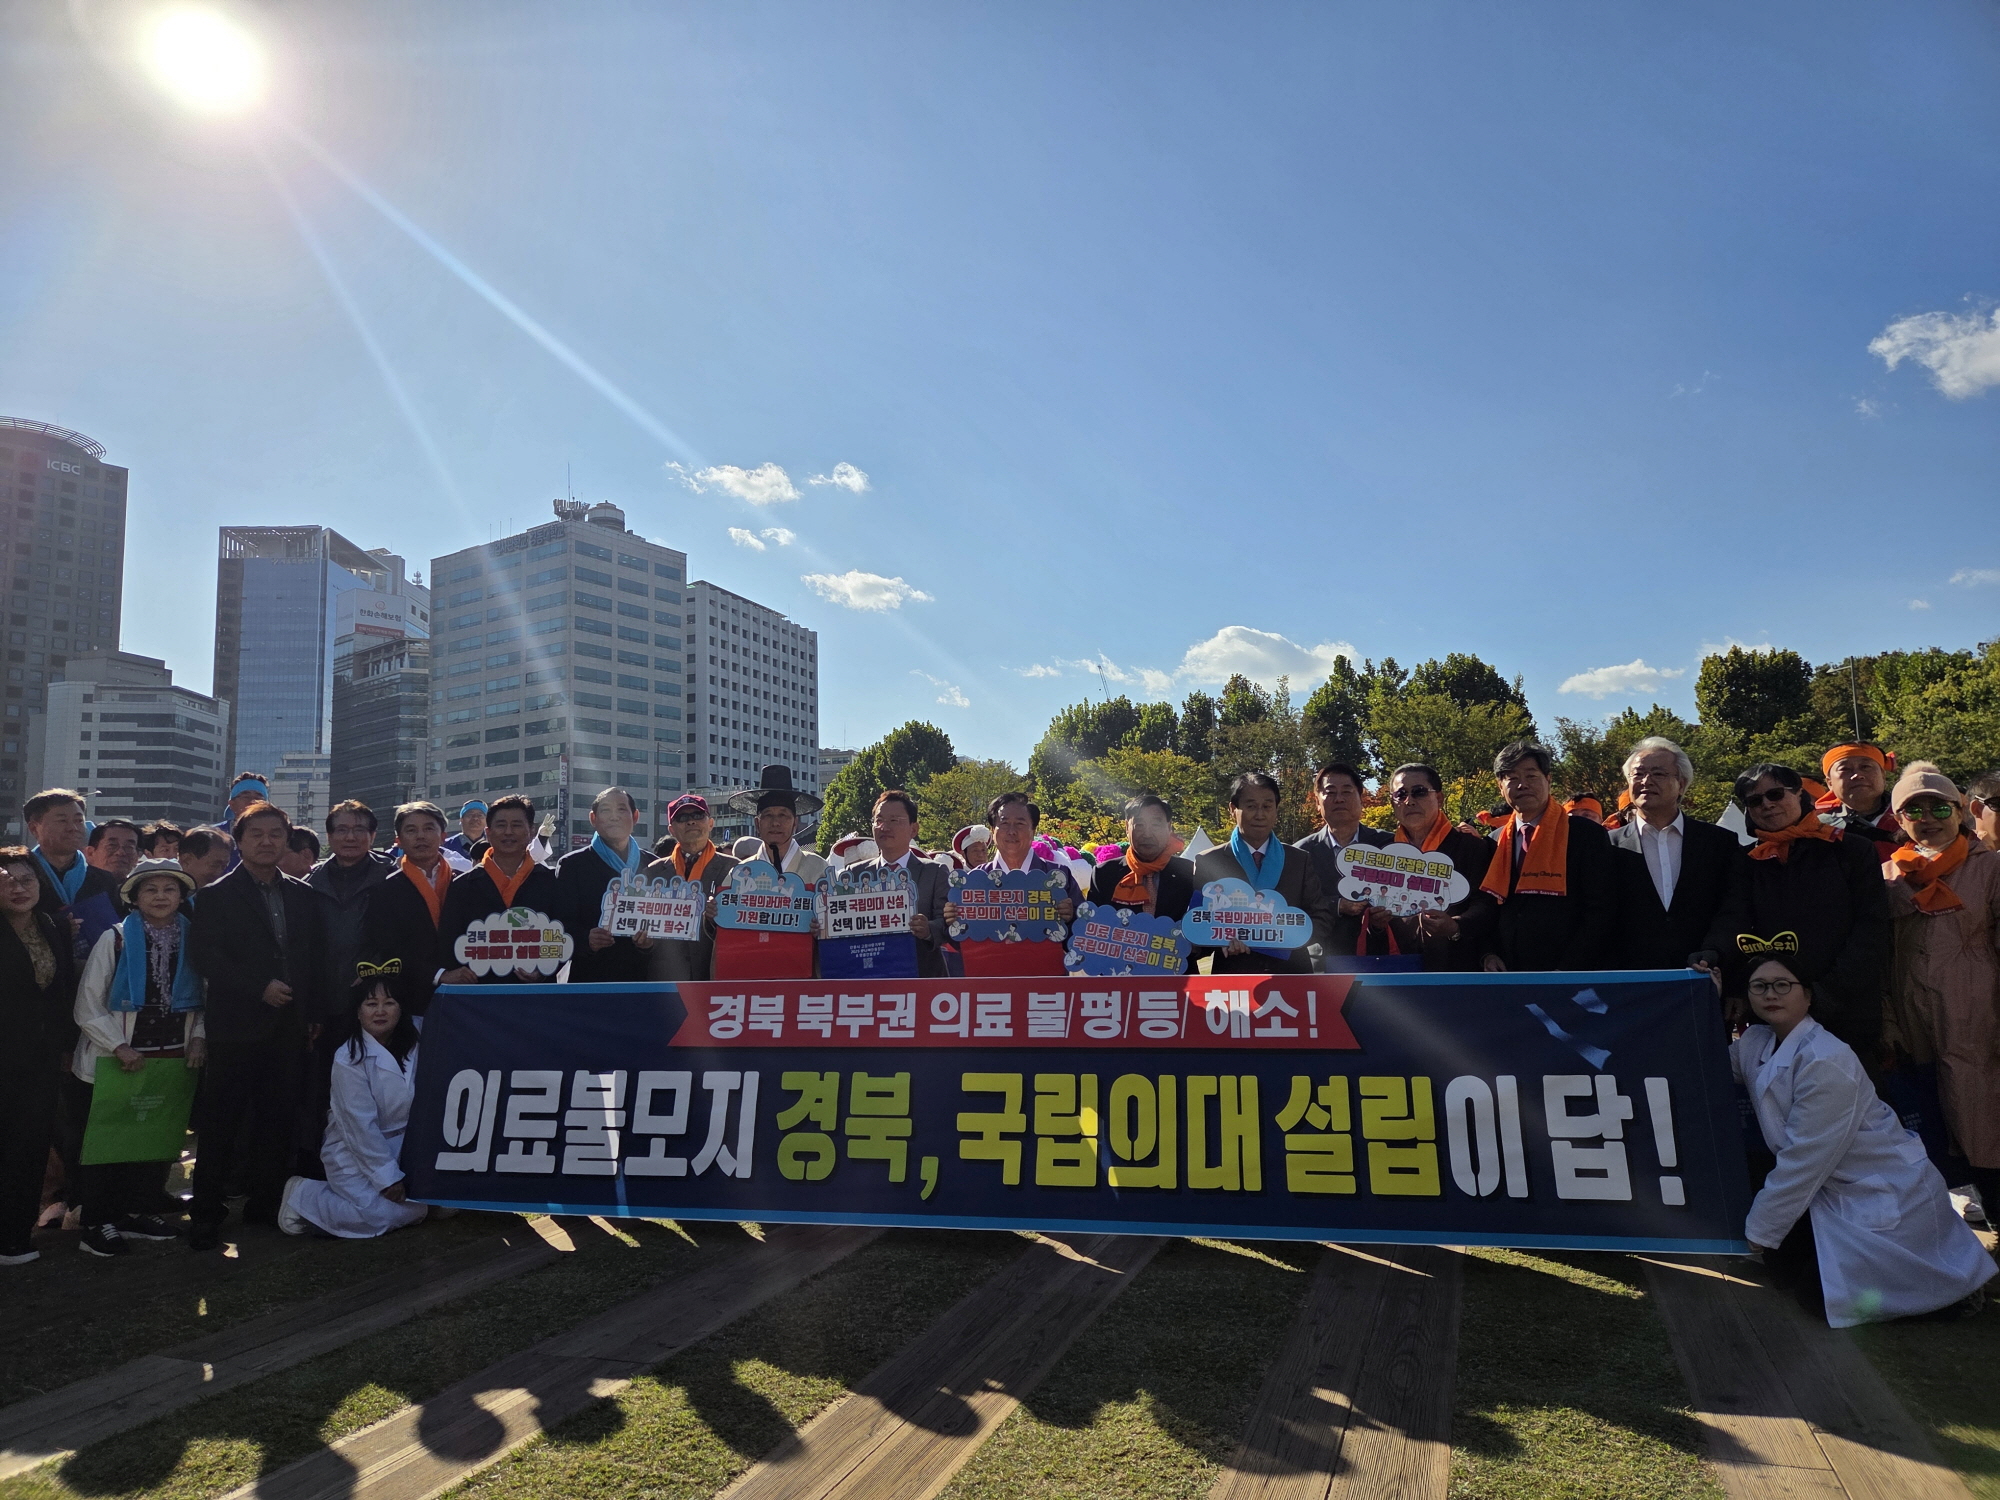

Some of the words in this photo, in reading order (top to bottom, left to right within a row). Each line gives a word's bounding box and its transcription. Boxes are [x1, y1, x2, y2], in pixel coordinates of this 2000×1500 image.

[47, 459, 81, 475] ICBC
[359, 608, 402, 623] 한화손해보험
[1344, 848, 1365, 864] 경북
[1365, 851, 1396, 869] 도민의
[1396, 857, 1428, 874] 간절한
[1427, 862, 1453, 880] 염원!
[1351, 865, 1406, 888] 국립의대
[721, 893, 739, 906] 경북
[740, 894, 792, 909] 국립의과대학
[829, 899, 848, 914] 경북
[848, 896, 885, 913] 국립의대
[886, 894, 908, 911] 신설,
[961, 889, 986, 904] 의료
[988, 889, 1025, 904] 불모지
[1027, 890, 1056, 906] 경북,
[617, 900, 636, 914] 경북
[636, 901, 673, 917] 국립의대
[673, 903, 694, 919] 신설,
[736, 910, 800, 927] 기원합니다!
[956, 905, 1002, 921] 국립의대
[1004, 906, 1040, 921] 신설이
[1192, 910, 1212, 924] 경북
[1213, 911, 1274, 926] 국립의과대학
[1275, 913, 1306, 927] 설립을
[616, 917, 638, 931] 선택
[640, 918, 661, 933] 아닌
[663, 920, 690, 935] 필수!
[832, 917, 854, 933] 선택
[855, 915, 877, 931] 아닌
[879, 912, 906, 929] 필수!
[467, 930, 487, 944] 경북
[542, 928, 567, 945] 해소,
[1084, 922, 1111, 940] 의료
[1112, 926, 1150, 947] 불모지
[1150, 935, 1179, 955] 경북,
[1211, 926, 1284, 943] 기원합니다!
[1073, 935, 1123, 959] 국립의대
[1122, 945, 1161, 967] 신설이
[1161, 954, 1183, 973] 답!
[708, 994, 785, 1039] 경북
[797, 992, 917, 1039] 북부권
[929, 992, 1014, 1038] 의료
[1204, 989, 1319, 1039] 해소!
[434, 1068, 760, 1179] 의료불모지
[775, 1071, 940, 1201] 경북,
[956, 1072, 1263, 1192] 국립의대
[1274, 1074, 1530, 1199] 설립이
[1542, 1074, 1686, 1206] 답!
